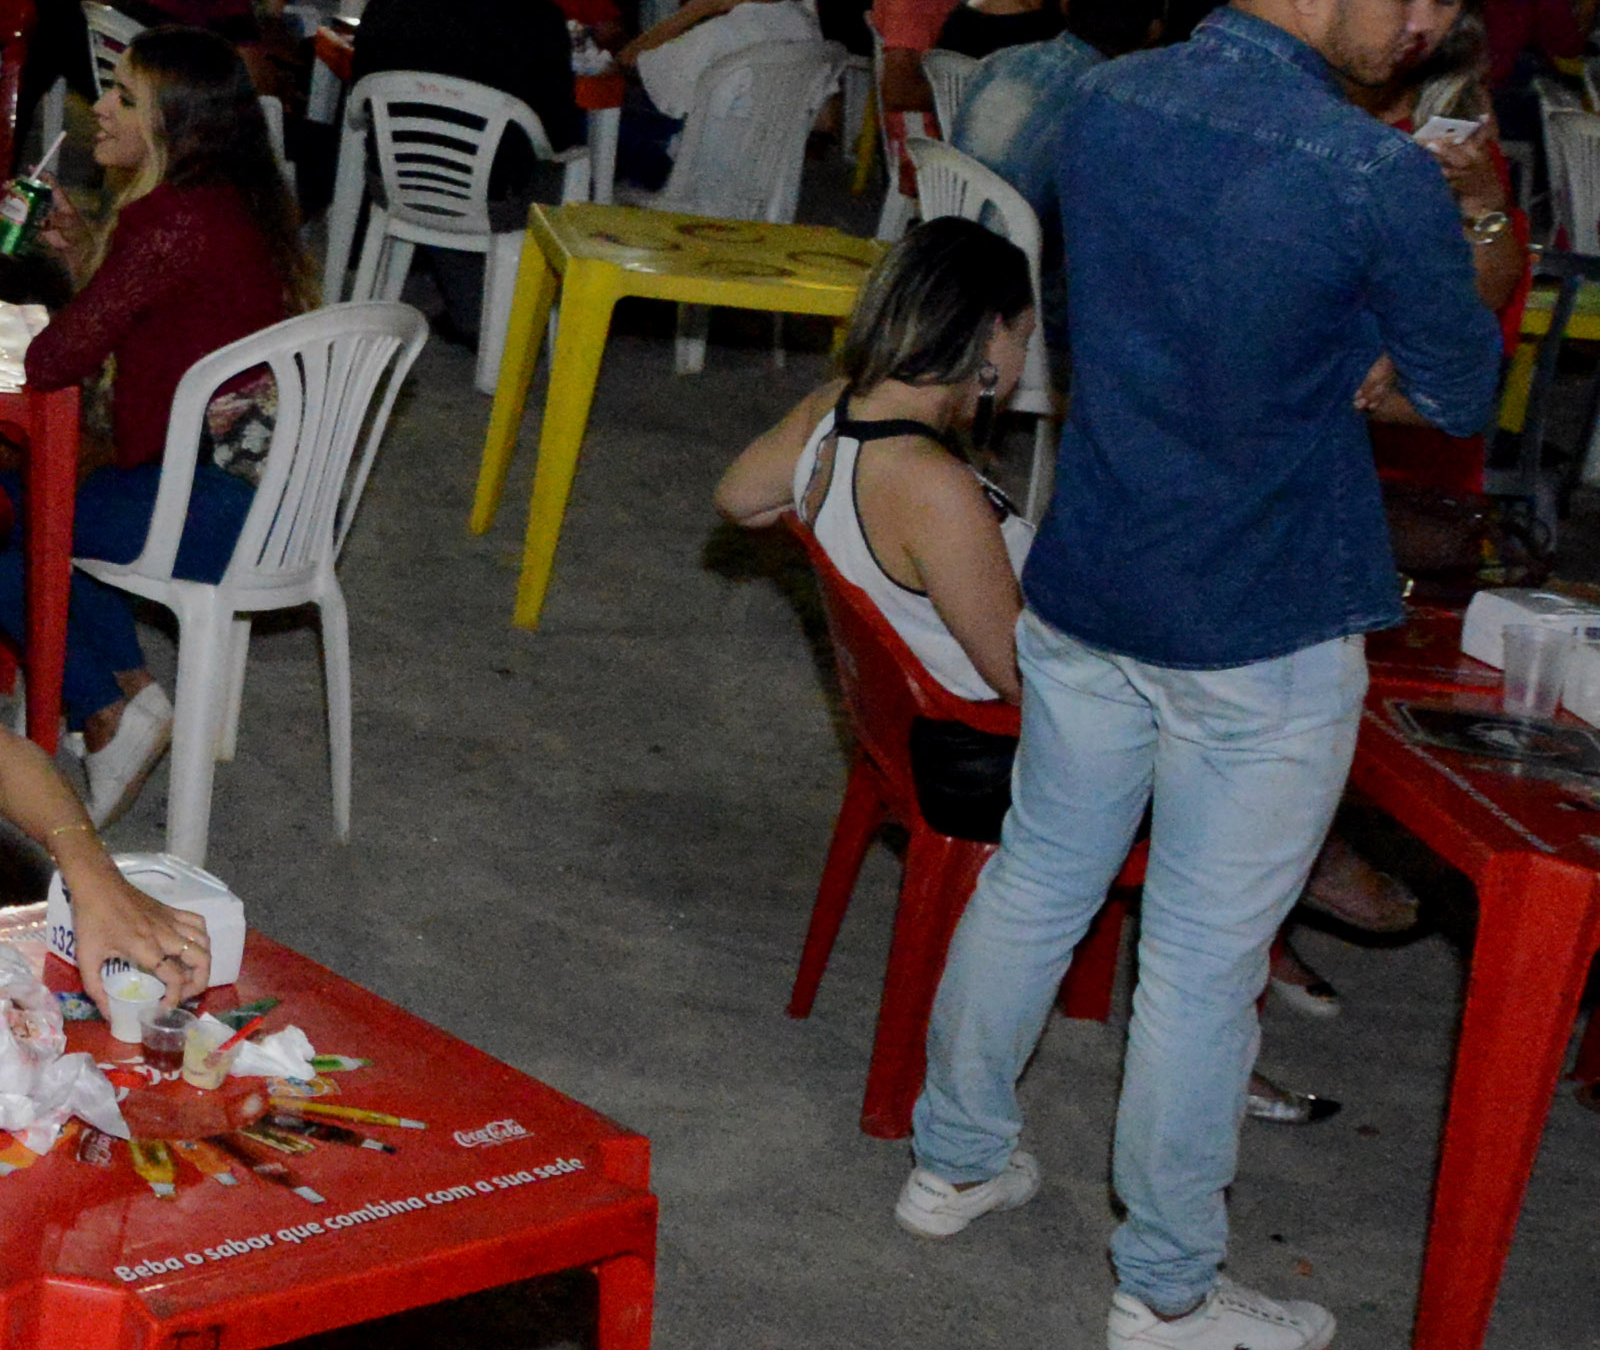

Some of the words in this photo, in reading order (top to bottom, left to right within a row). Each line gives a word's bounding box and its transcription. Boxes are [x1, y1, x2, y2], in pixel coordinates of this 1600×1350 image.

[453, 1118, 535, 1149] Coca-Cola
[113, 1256, 183, 1283] Beba
[184, 1249, 206, 1267] o
[204, 1231, 275, 1262] sabor
[276, 1219, 326, 1245] que
[325, 1195, 426, 1231] combina
[425, 1183, 477, 1207] com
[478, 1179, 494, 1194] a
[491, 1169, 534, 1190] sua
[534, 1155, 586, 1180] sede
